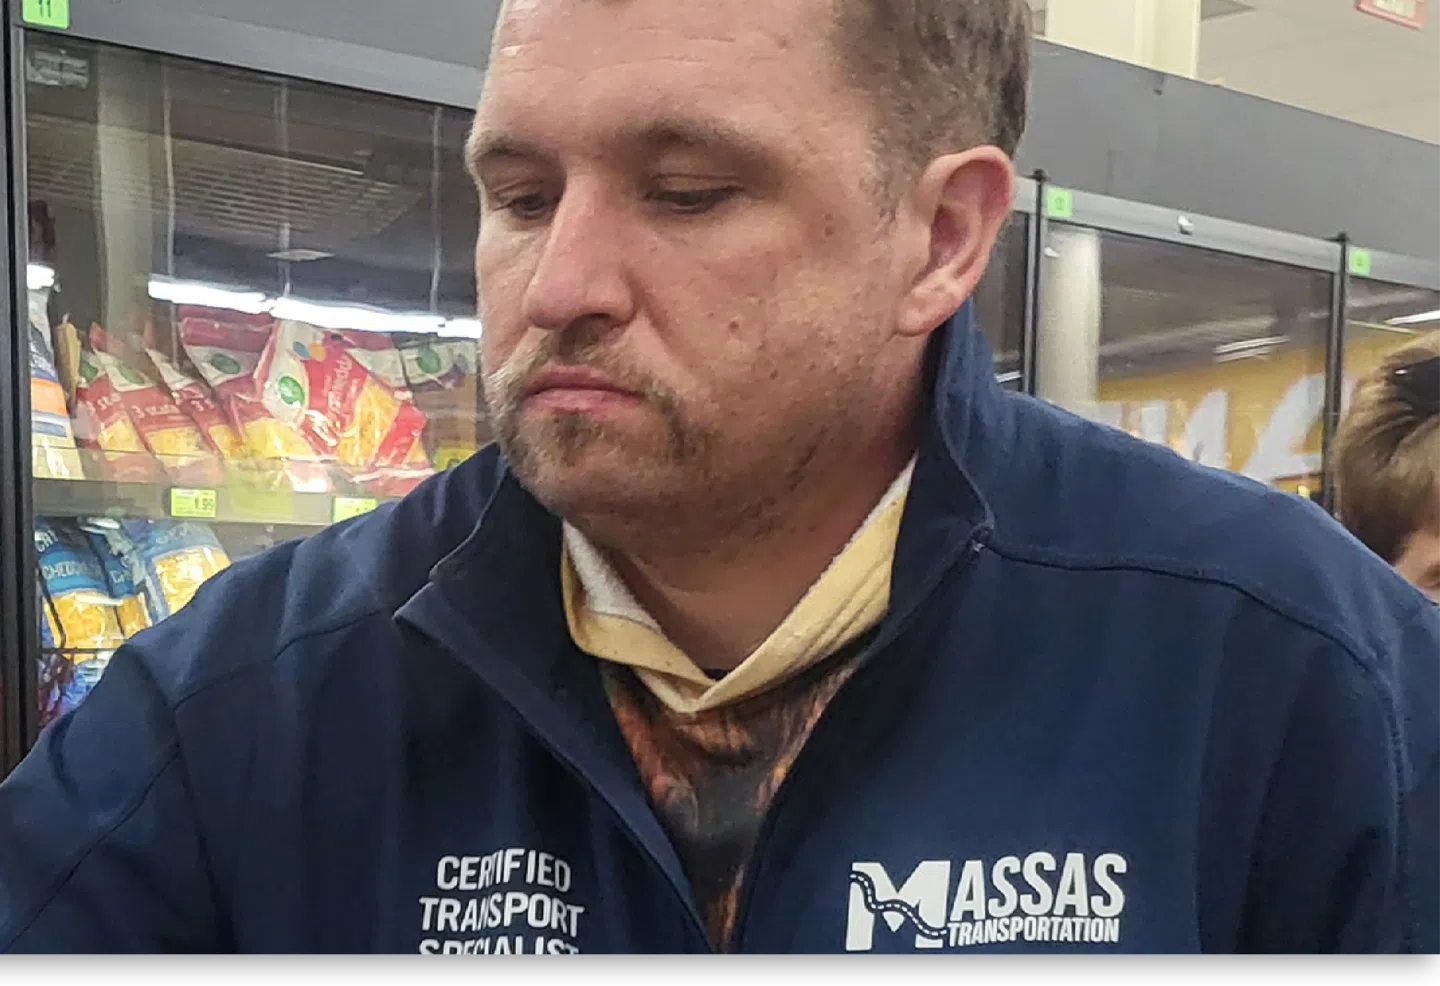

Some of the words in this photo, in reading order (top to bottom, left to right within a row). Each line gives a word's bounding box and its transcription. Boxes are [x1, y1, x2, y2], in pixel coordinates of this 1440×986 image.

[437, 848, 571, 892] CERTIFIED
[419, 891, 585, 938] TRANSPORT
[947, 916, 1120, 947] TRANSPORTATION
